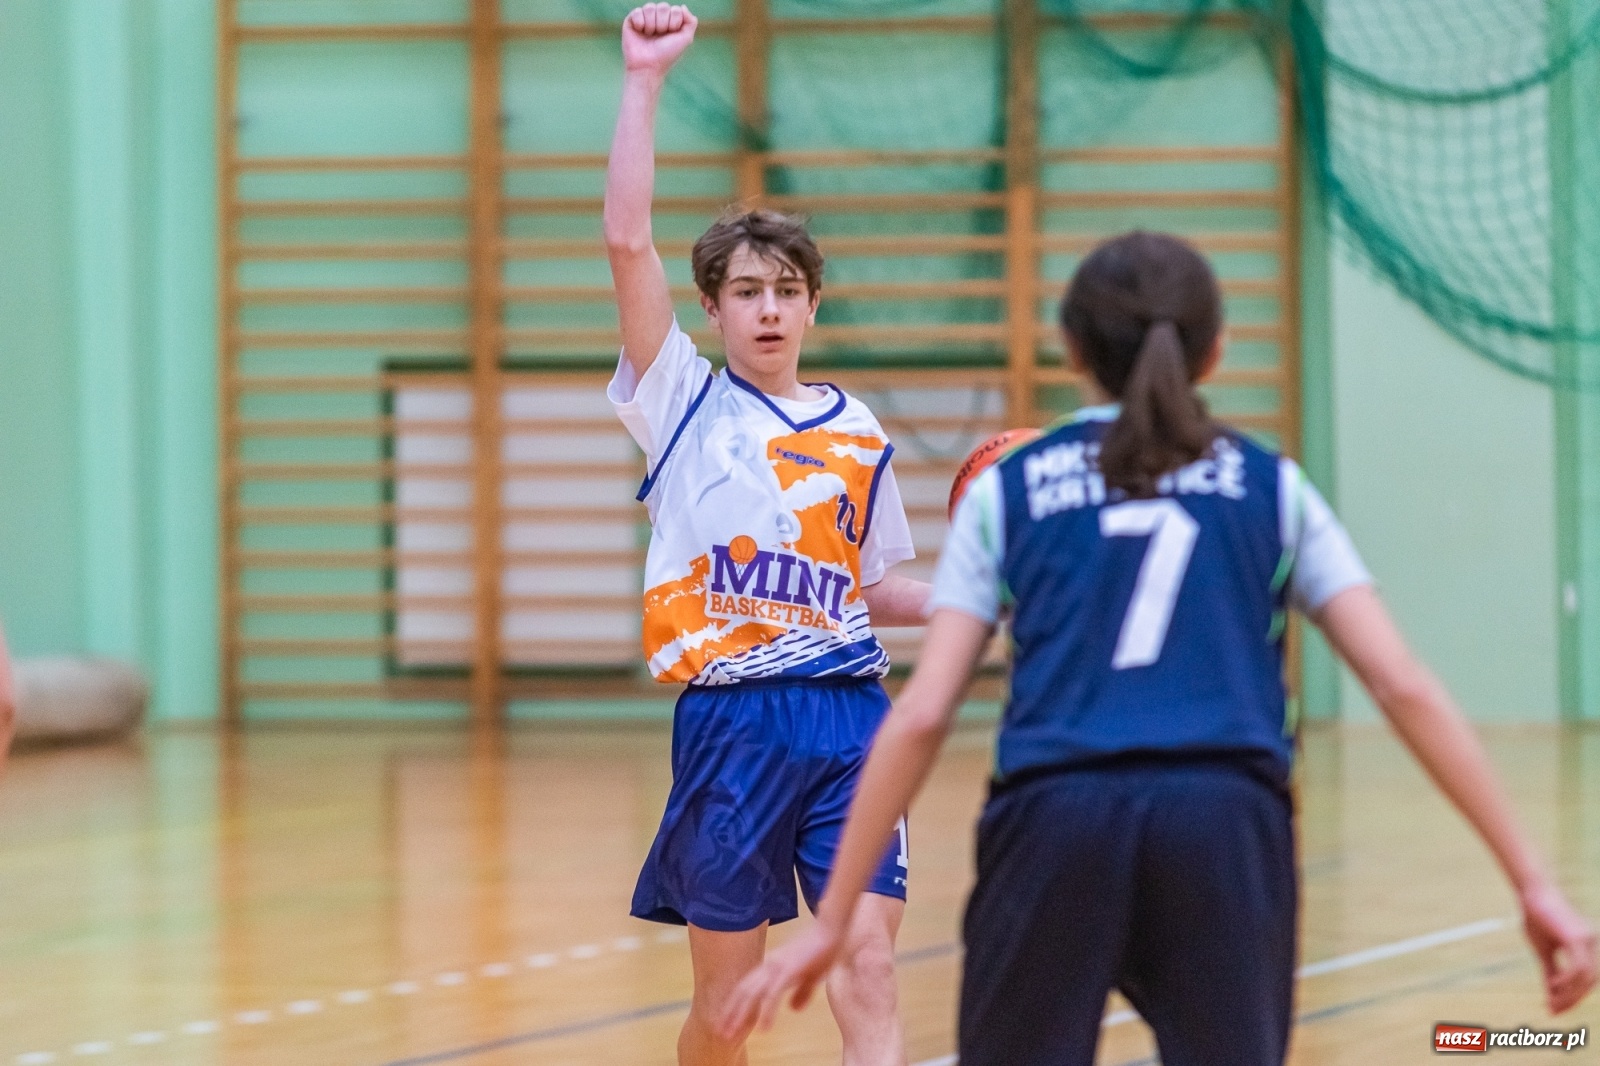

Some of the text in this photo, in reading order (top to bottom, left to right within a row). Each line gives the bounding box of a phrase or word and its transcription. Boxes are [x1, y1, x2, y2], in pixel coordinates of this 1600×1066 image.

[710, 594, 848, 639] BASKETBA
[711, 543, 852, 622] MINI
[1099, 498, 1199, 670] 7
